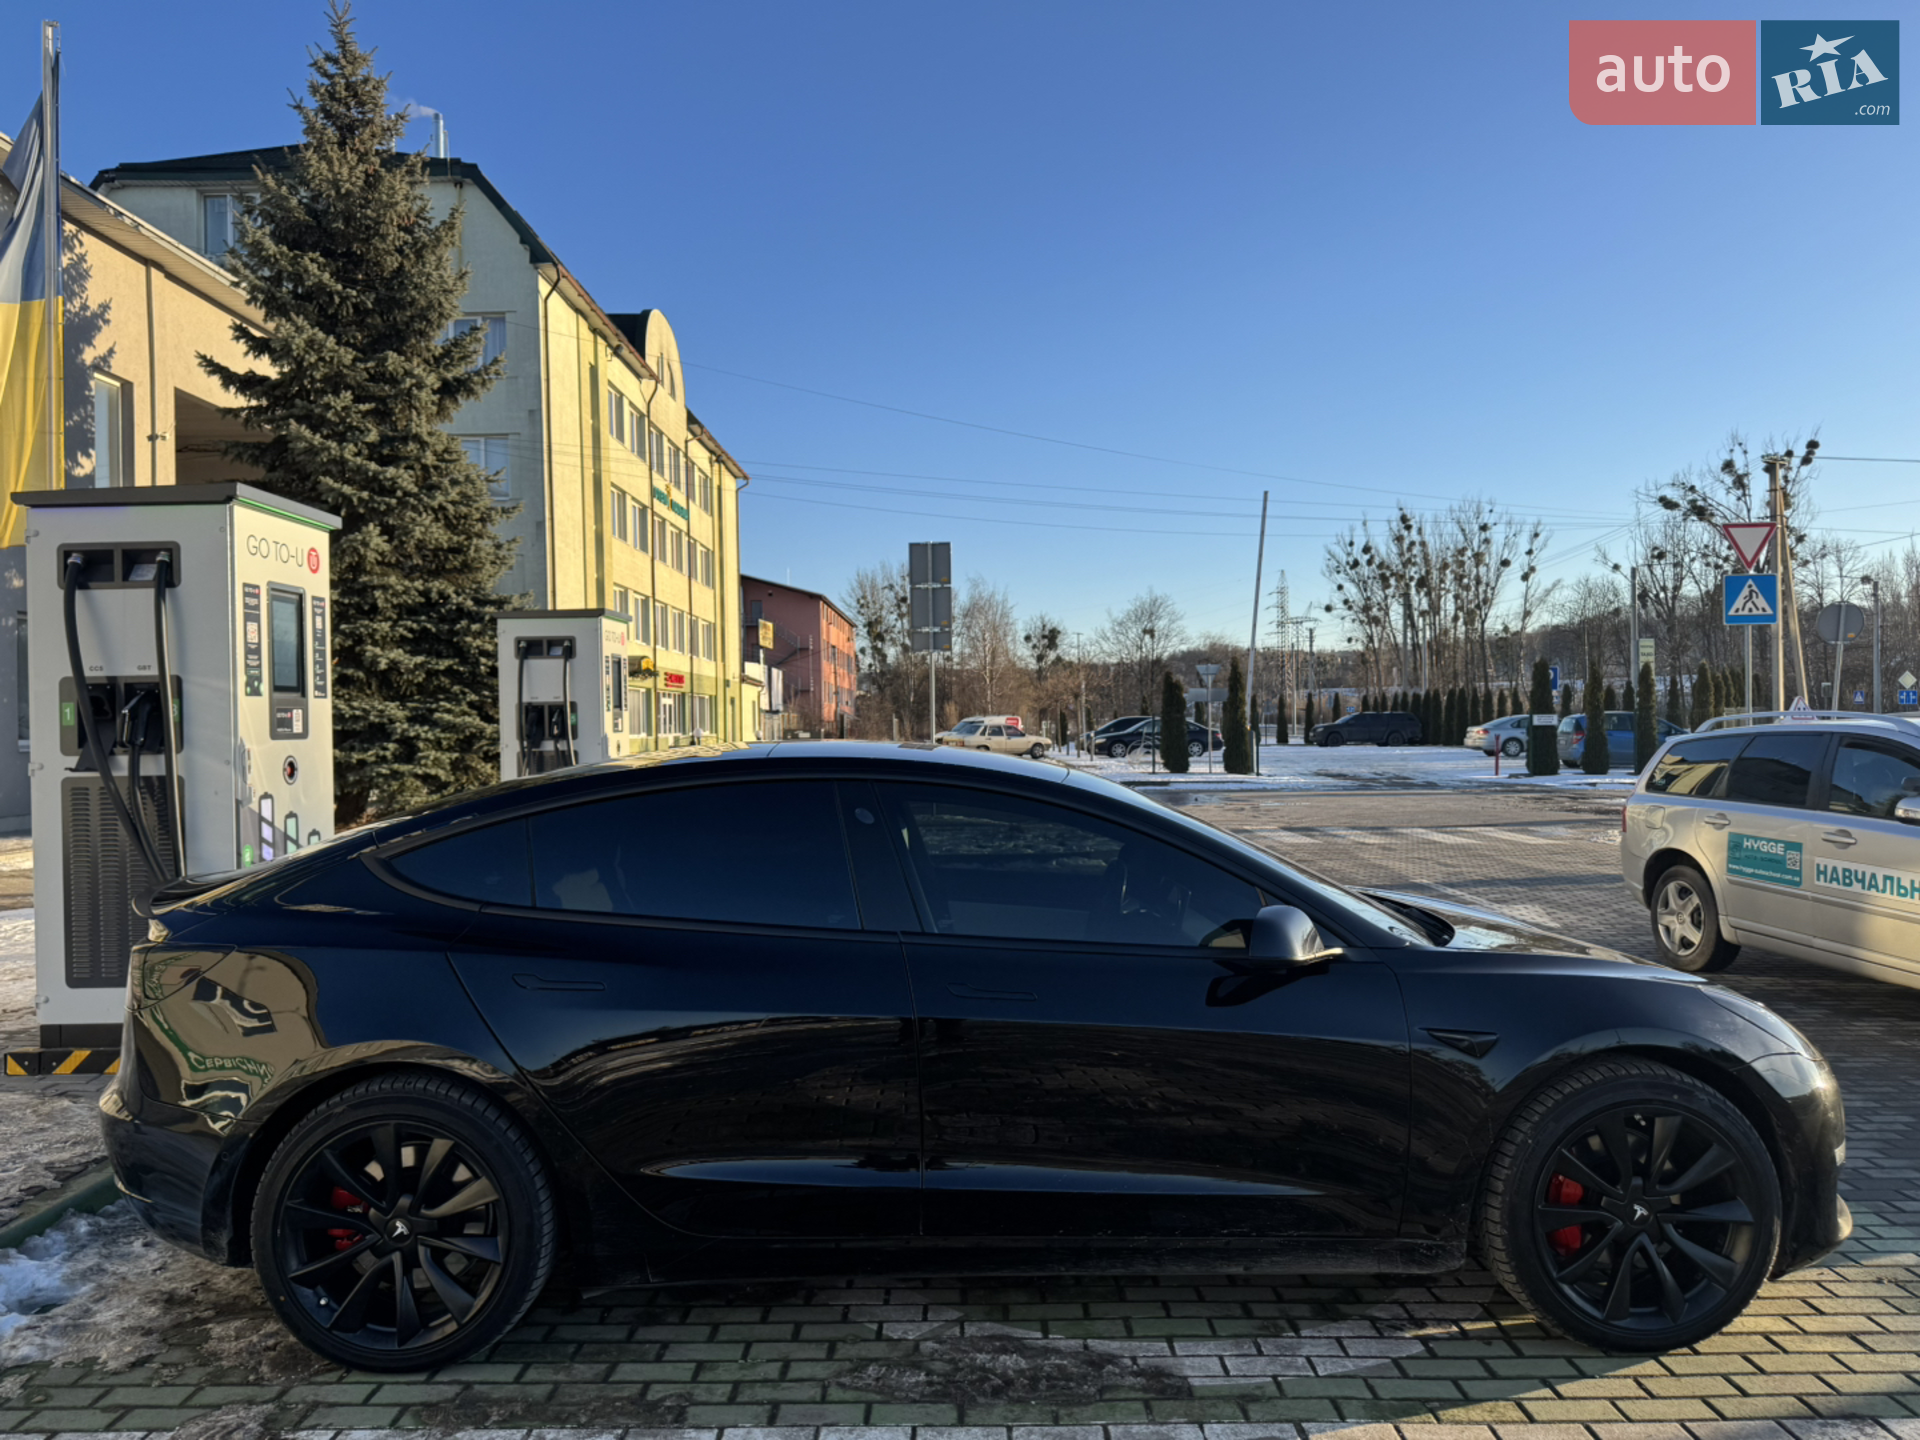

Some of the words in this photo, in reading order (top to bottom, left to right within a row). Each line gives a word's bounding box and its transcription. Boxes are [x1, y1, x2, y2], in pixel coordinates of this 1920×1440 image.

[246, 534, 270, 559] GO
[272, 540, 304, 568] TO-U
[64, 707, 71, 721] 1
[1743, 837, 1785, 855] HYGGE
